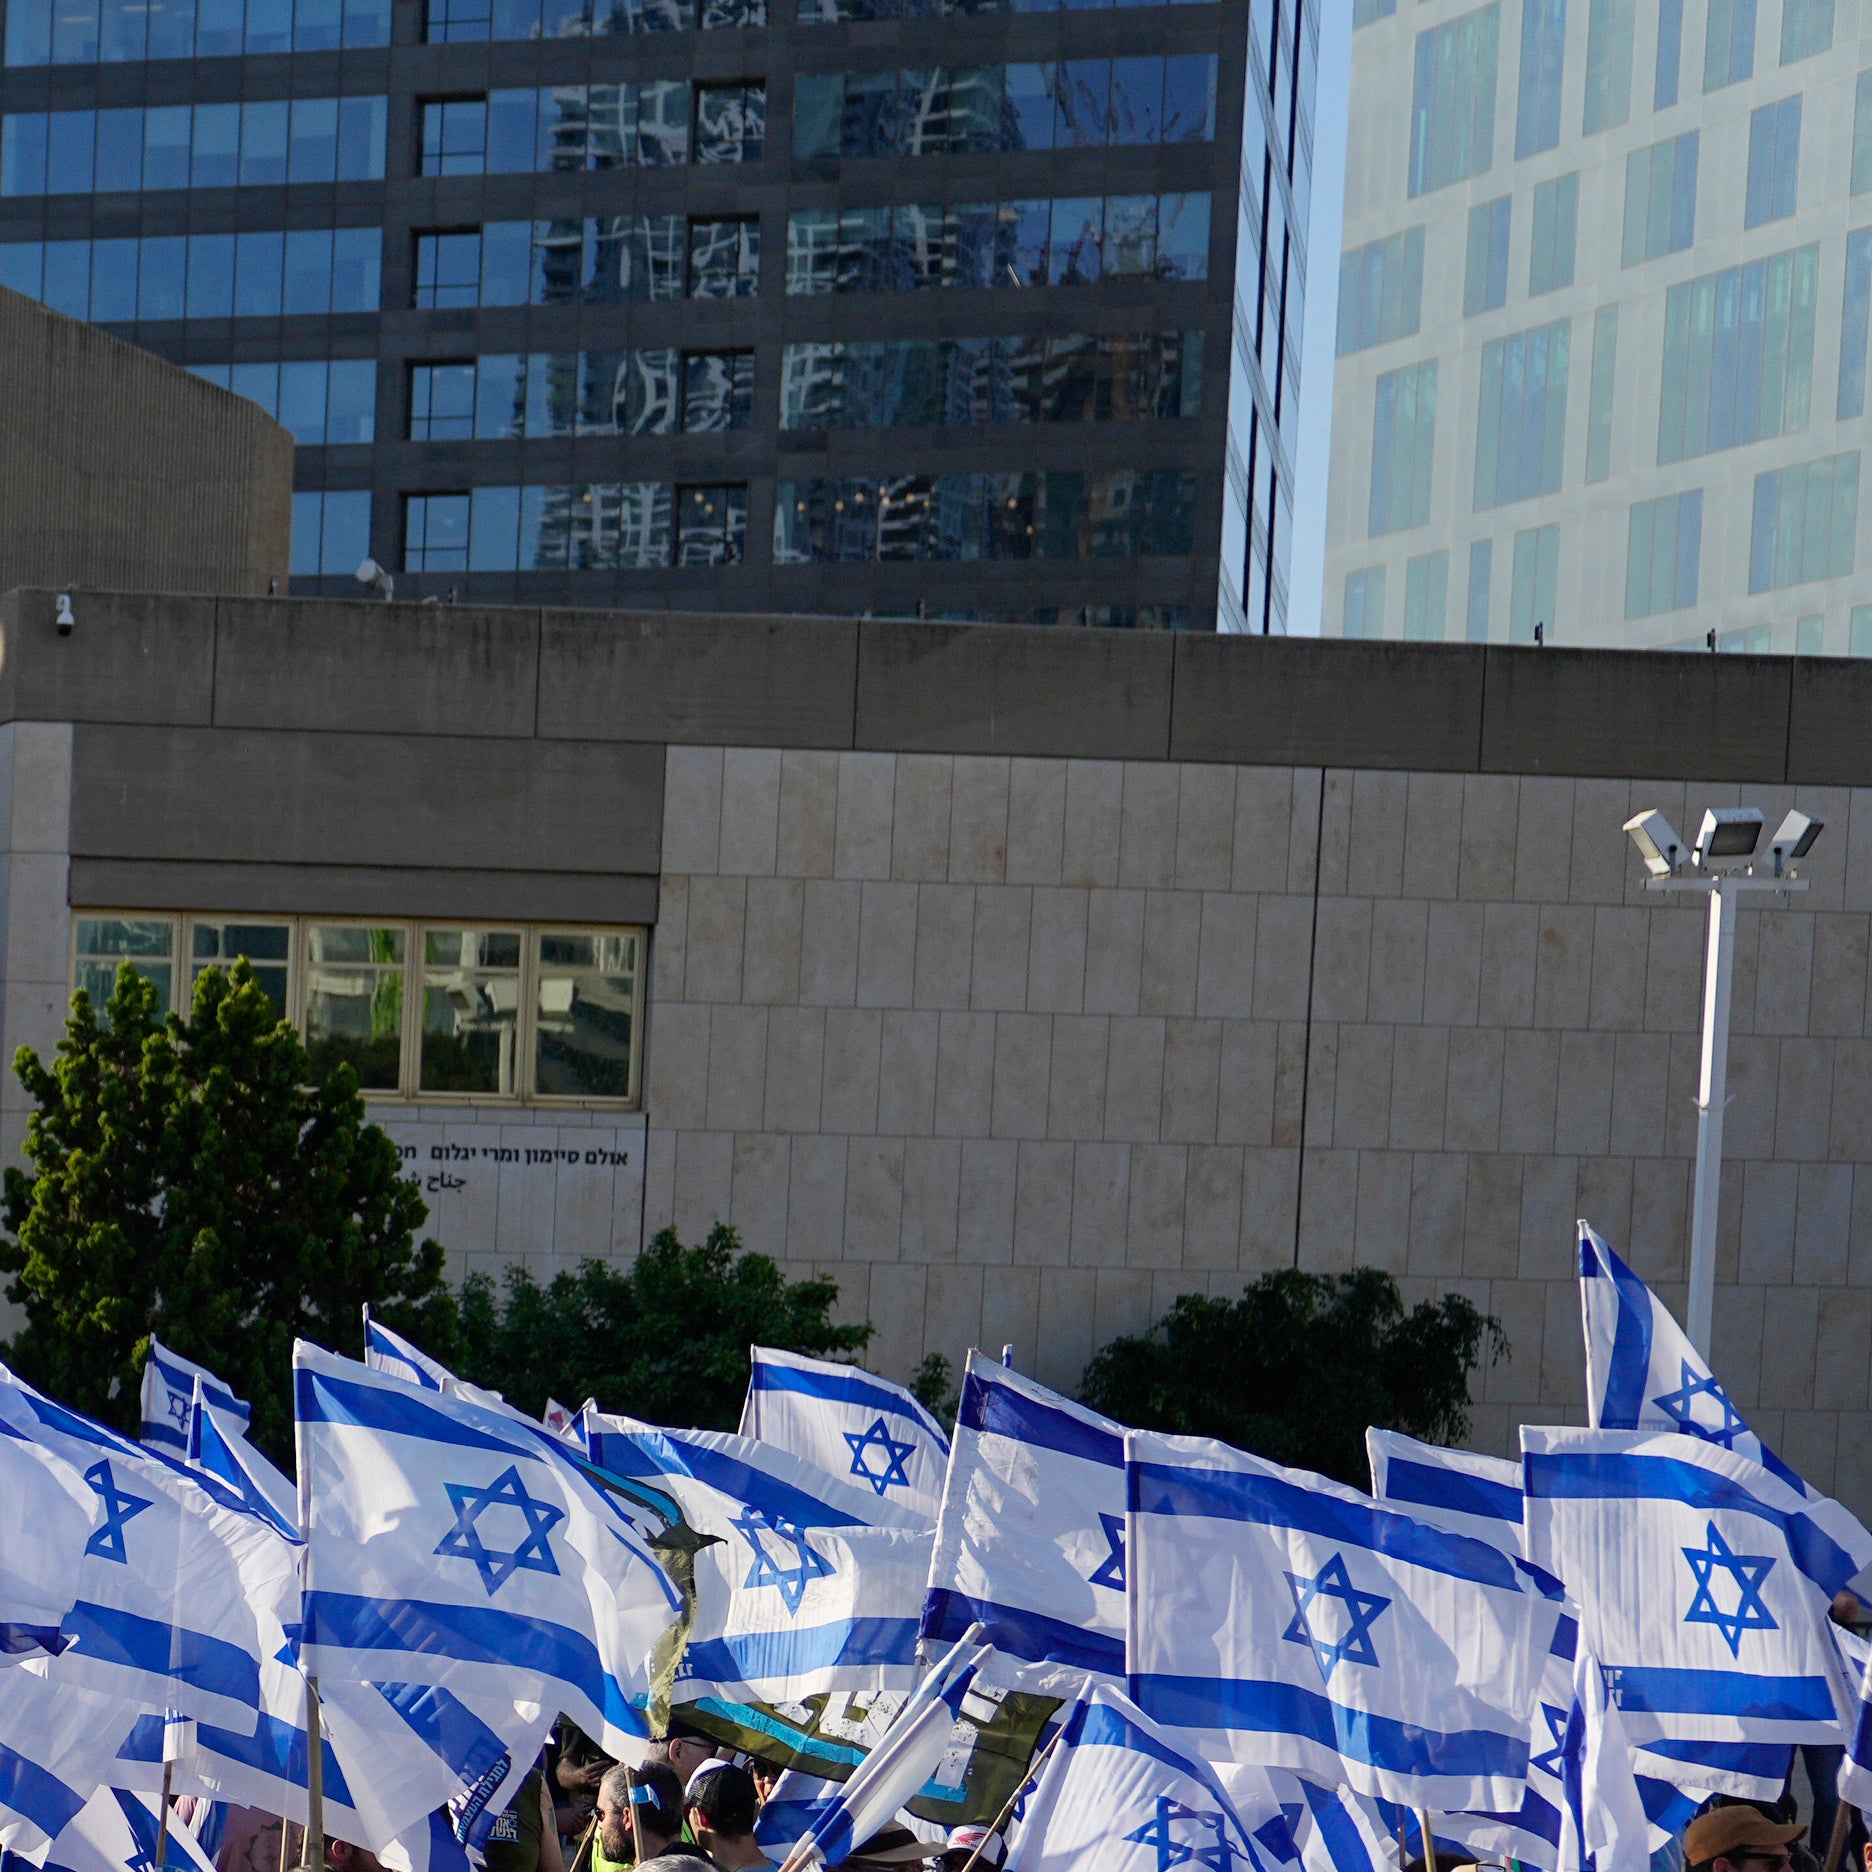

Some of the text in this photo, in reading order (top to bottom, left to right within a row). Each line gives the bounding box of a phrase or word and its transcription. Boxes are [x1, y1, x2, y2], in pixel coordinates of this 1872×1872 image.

[431, 1144, 477, 1162] יגלום
[482, 1147, 521, 1163] ומרי
[525, 1147, 580, 1168] סיימון
[585, 1149, 628, 1166] אולם
